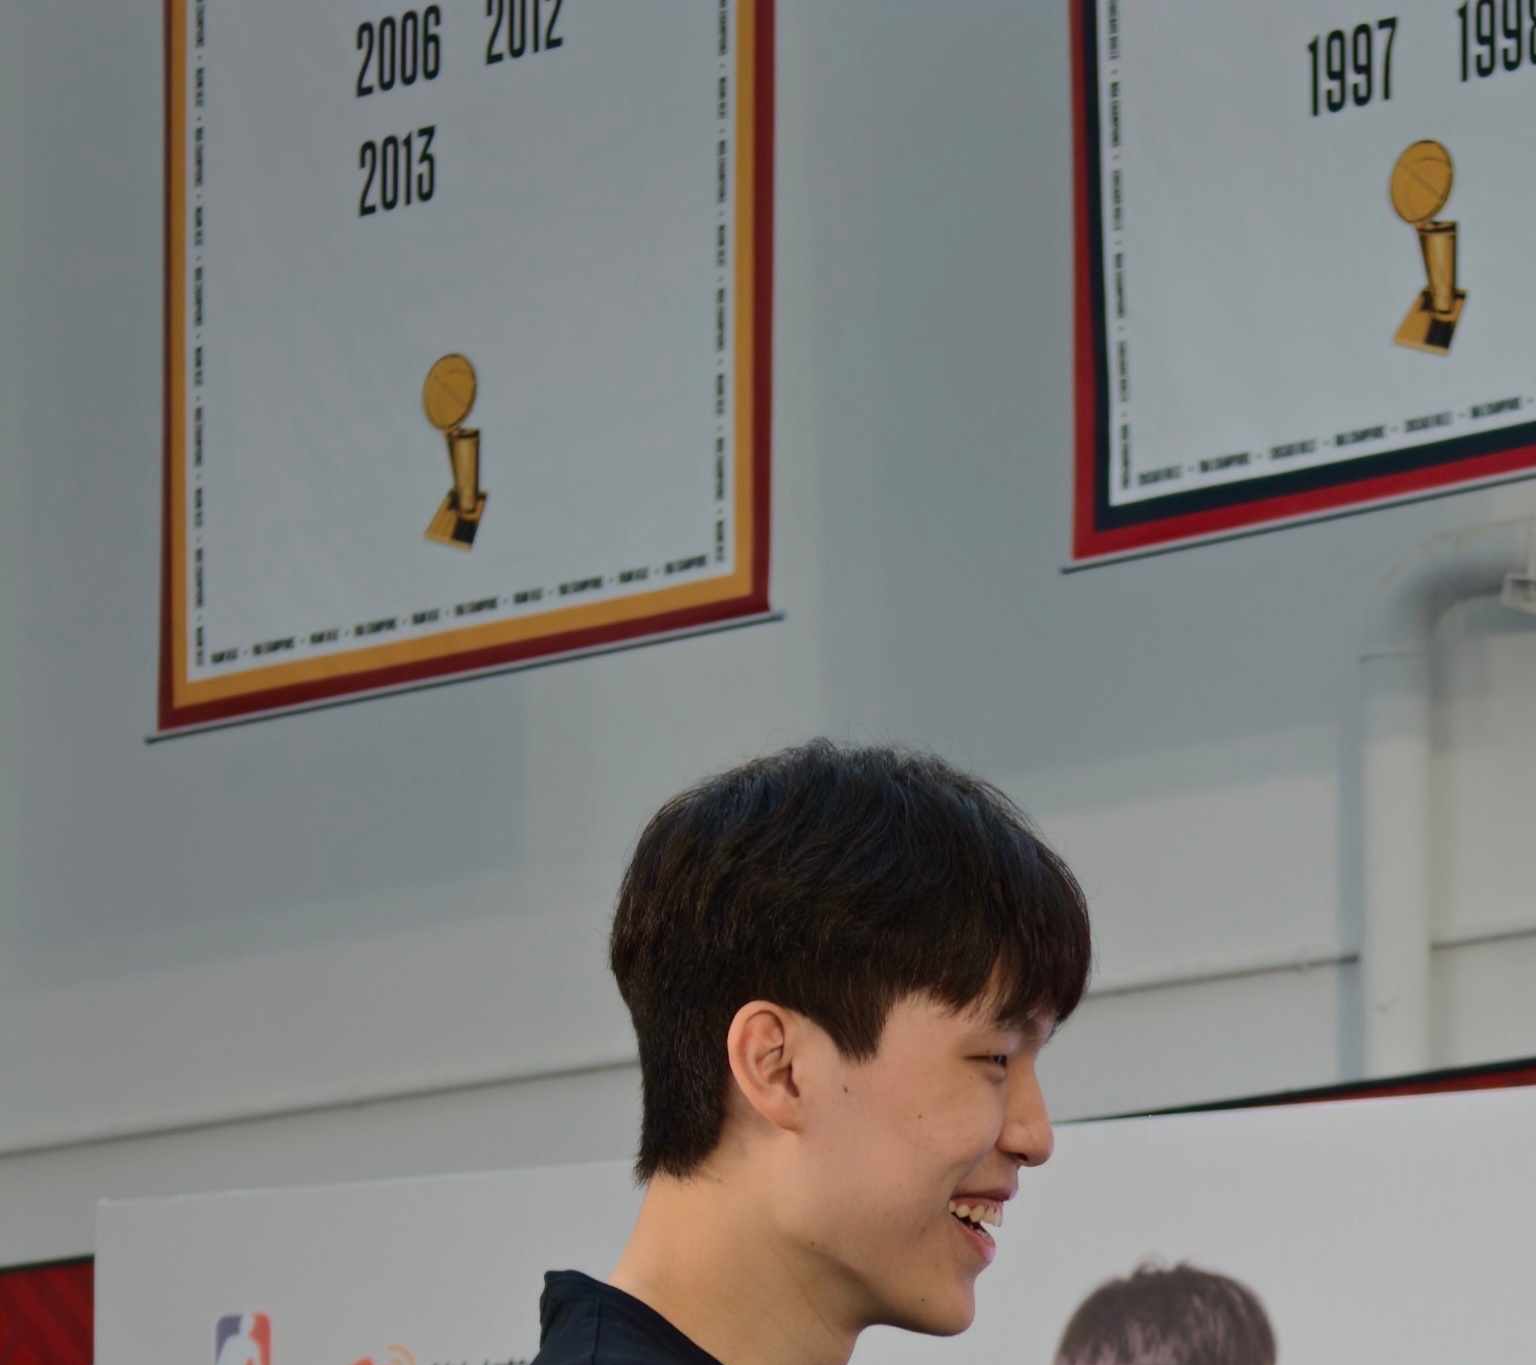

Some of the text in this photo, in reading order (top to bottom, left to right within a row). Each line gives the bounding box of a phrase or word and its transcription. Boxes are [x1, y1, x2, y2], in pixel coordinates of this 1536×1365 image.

[355, 4, 442, 97] 2006
[1306, 17, 1398, 116] 1997
[358, 125, 437, 217] 2013
